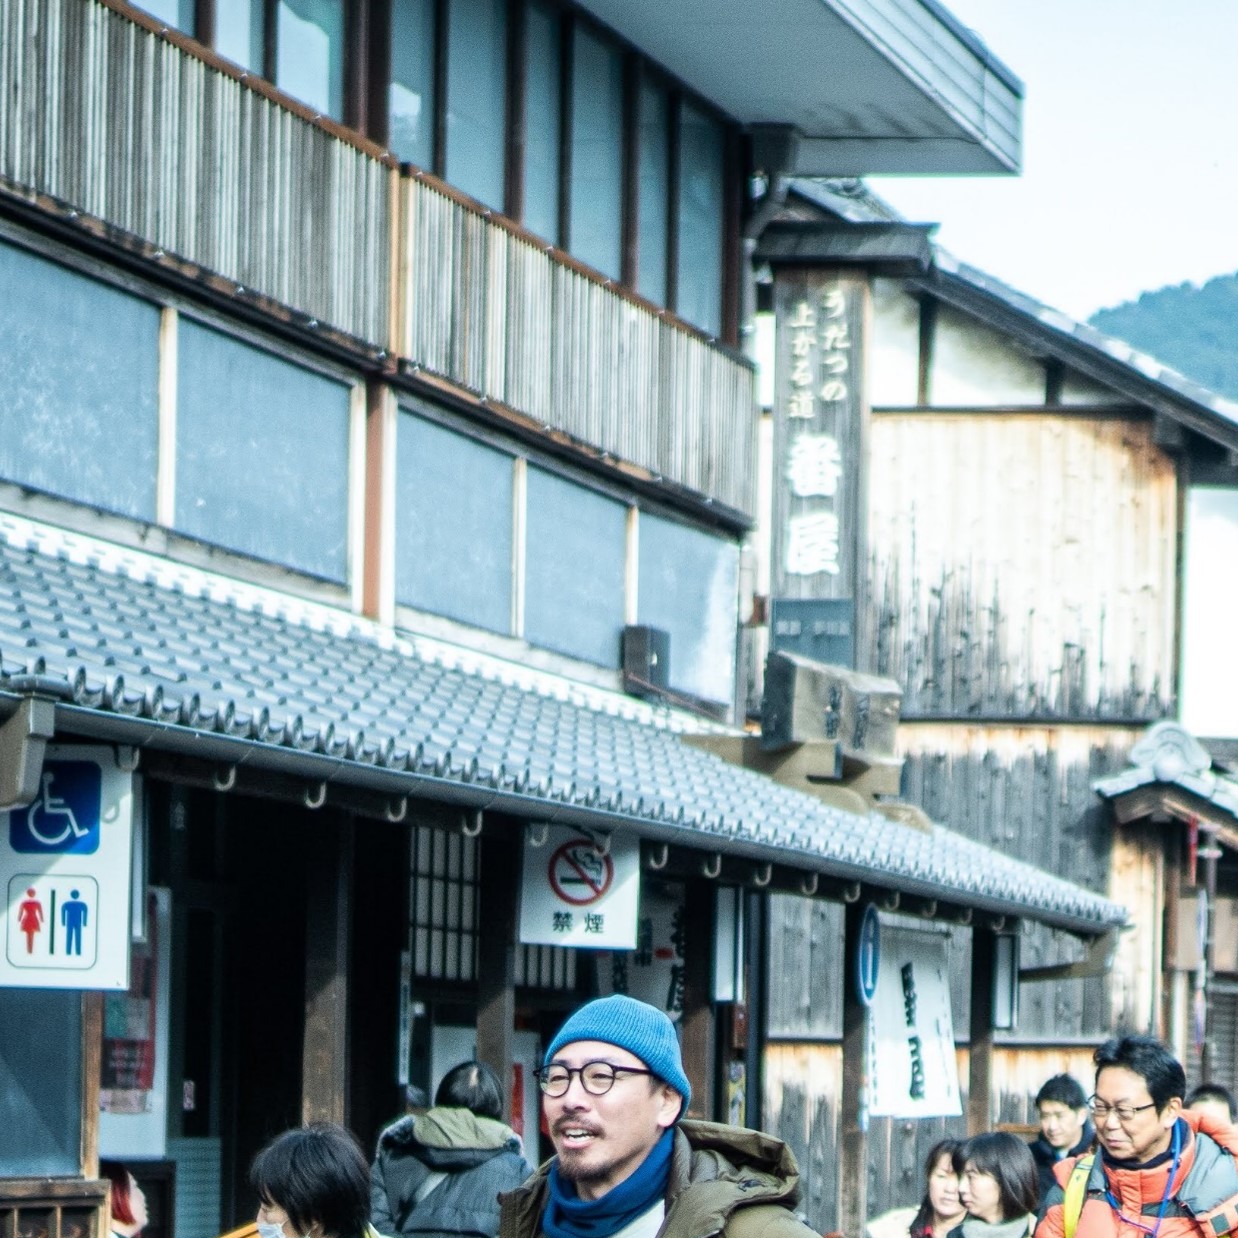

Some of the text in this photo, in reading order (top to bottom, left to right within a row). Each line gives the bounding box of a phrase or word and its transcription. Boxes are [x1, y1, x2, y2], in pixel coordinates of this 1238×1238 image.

[821, 290, 851, 401] うだつの
[552, 911, 605, 934] 禁煙
